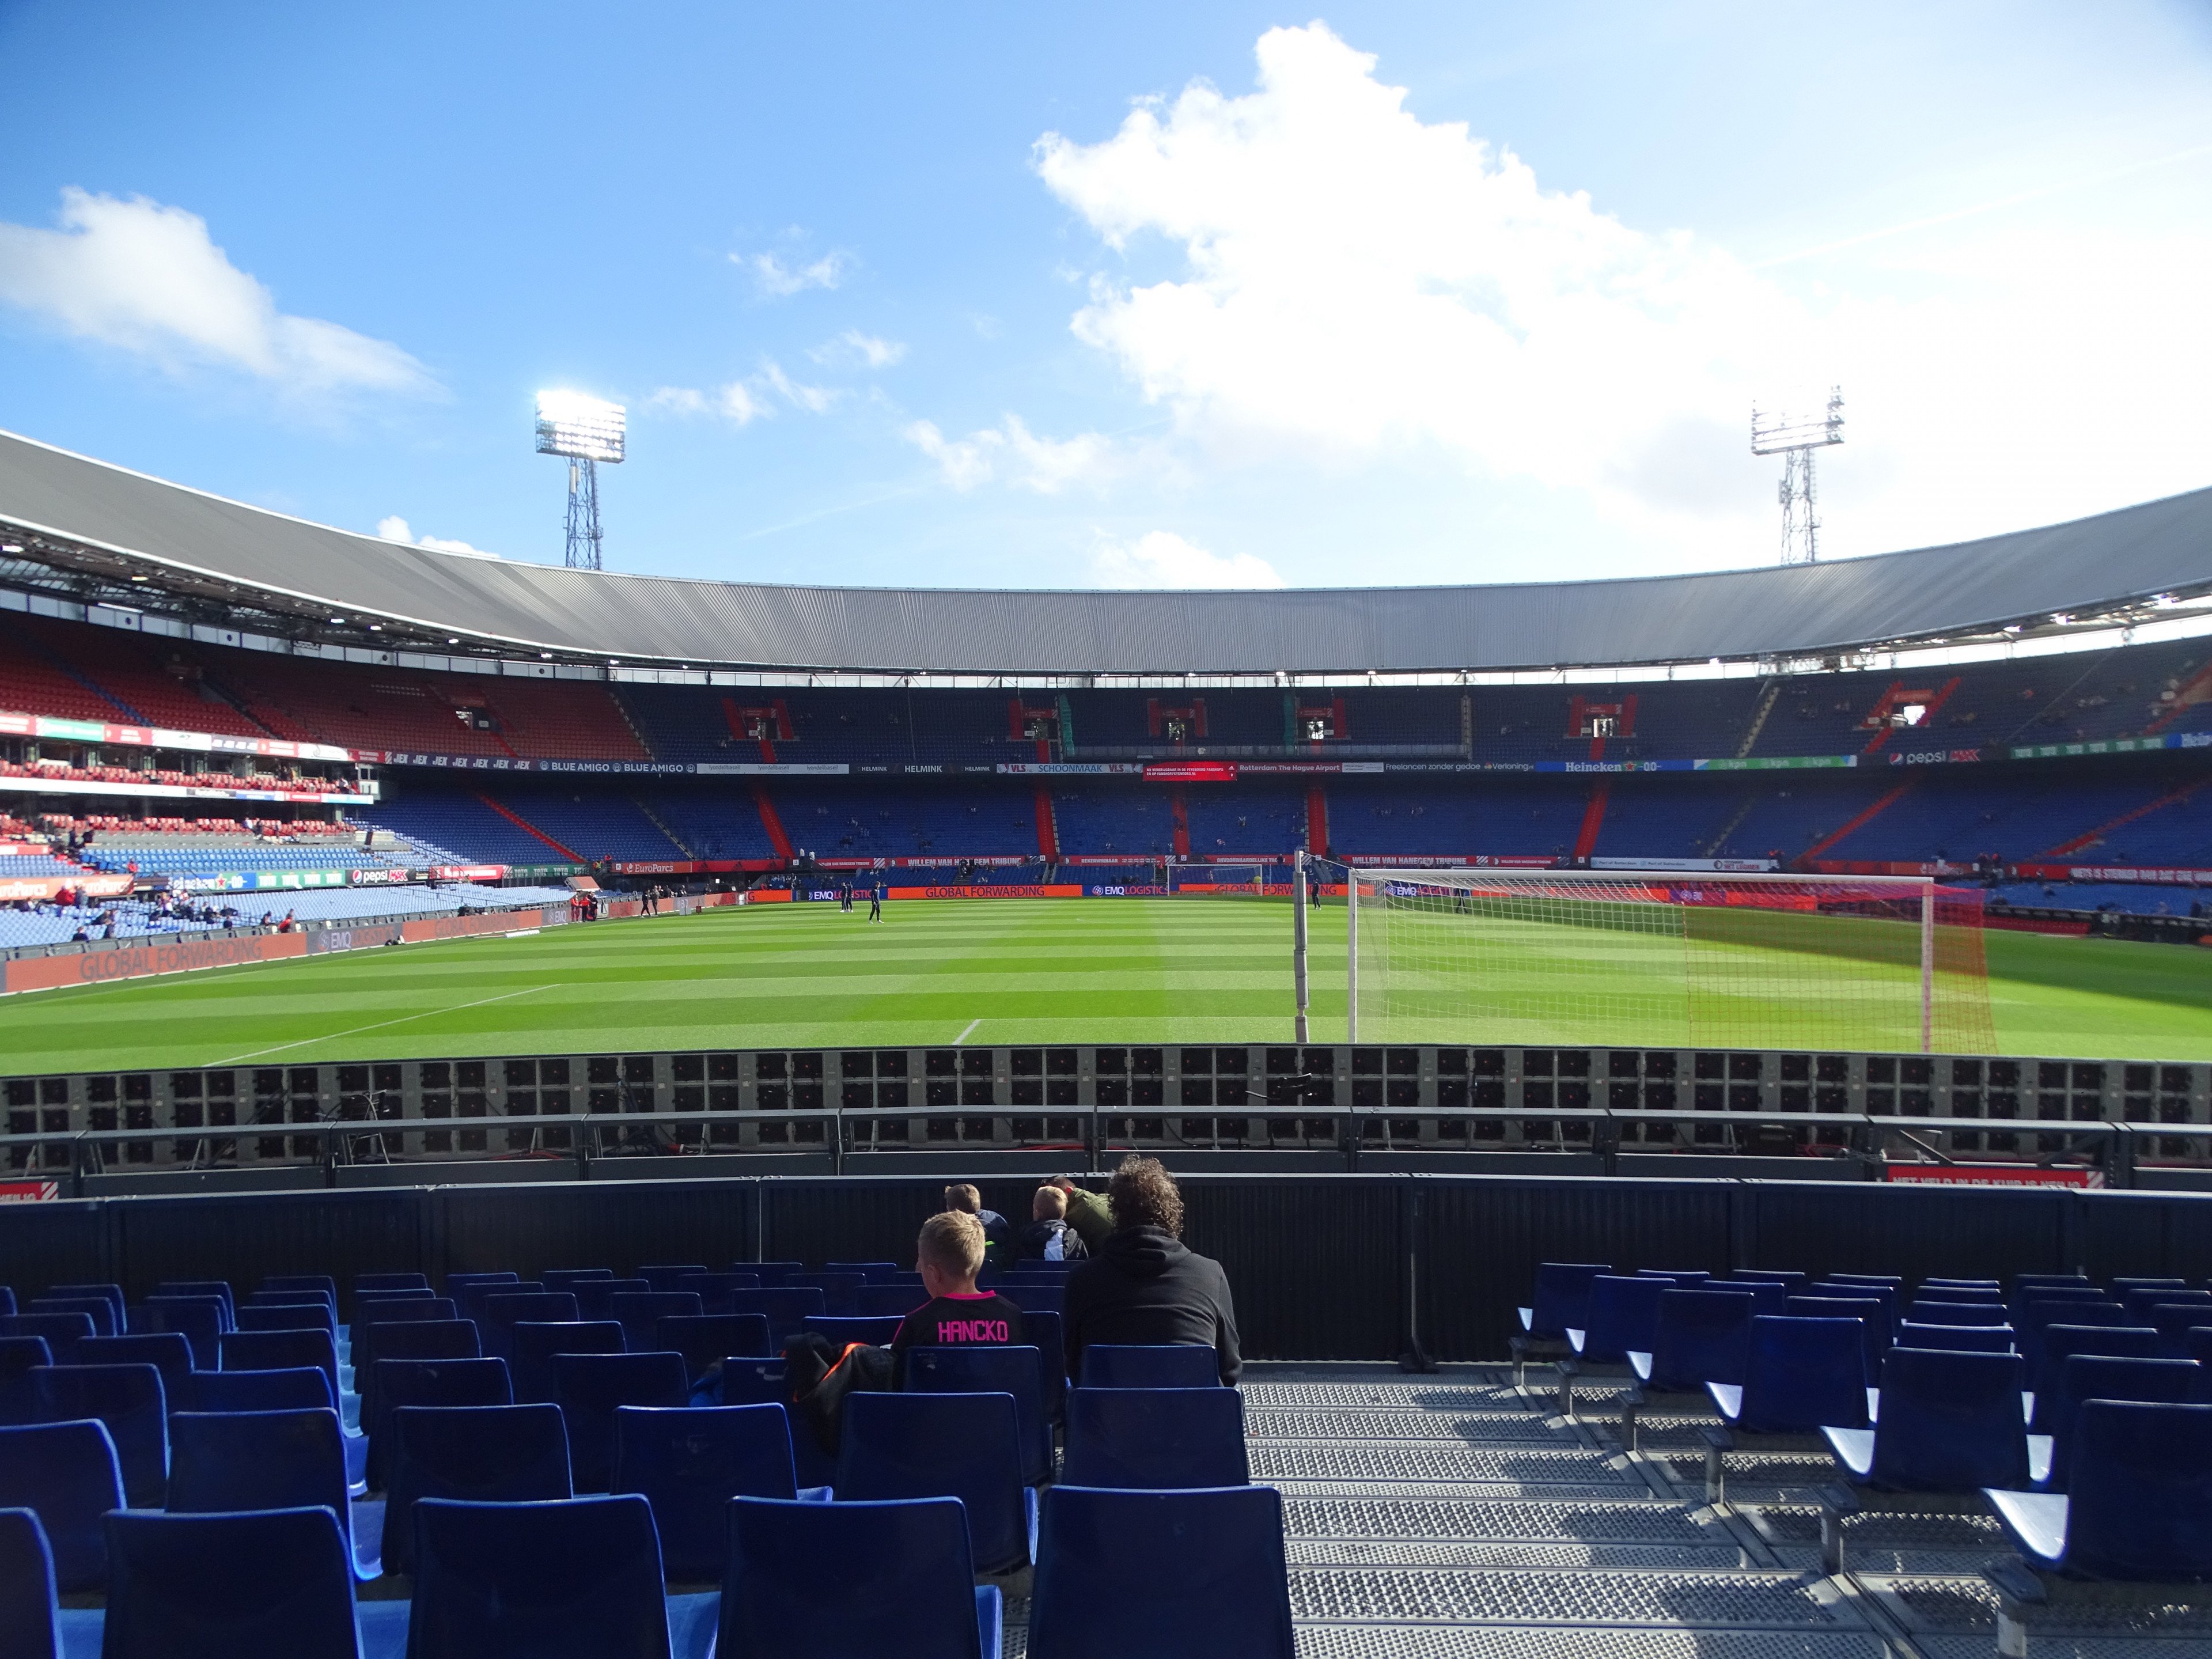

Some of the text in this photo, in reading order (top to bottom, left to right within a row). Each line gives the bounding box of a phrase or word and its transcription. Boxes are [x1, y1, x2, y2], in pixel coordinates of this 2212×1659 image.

[393, 753, 530, 770] JEX JEX JEX JEX JEX JEX JEX
[1906, 751, 1946, 766] pepsi
[551, 762, 609, 771] BLUE AMIGO
[624, 764, 649, 772] BLUE
[1456, 763, 1481, 772] gedoe
[1565, 762, 1623, 772] Heineken
[553, 868, 569, 876] TOTO
[635, 863, 674, 873] EuroParcs
[363, 869, 408, 883] pepsi MAX
[926, 886, 1045, 897] GLOBAL FORWARDING
[1105, 886, 1124, 896] EMQ
[1263, 885, 1337, 895] FORWNG
[1397, 886, 1416, 896] EMQ
[814, 891, 834, 900] EMQ
[331, 925, 395, 949] EMQ LOGISTICS
[80, 938, 262, 980] GLOBAL FORWARDING
[938, 1320, 1008, 1342] HANCKO
